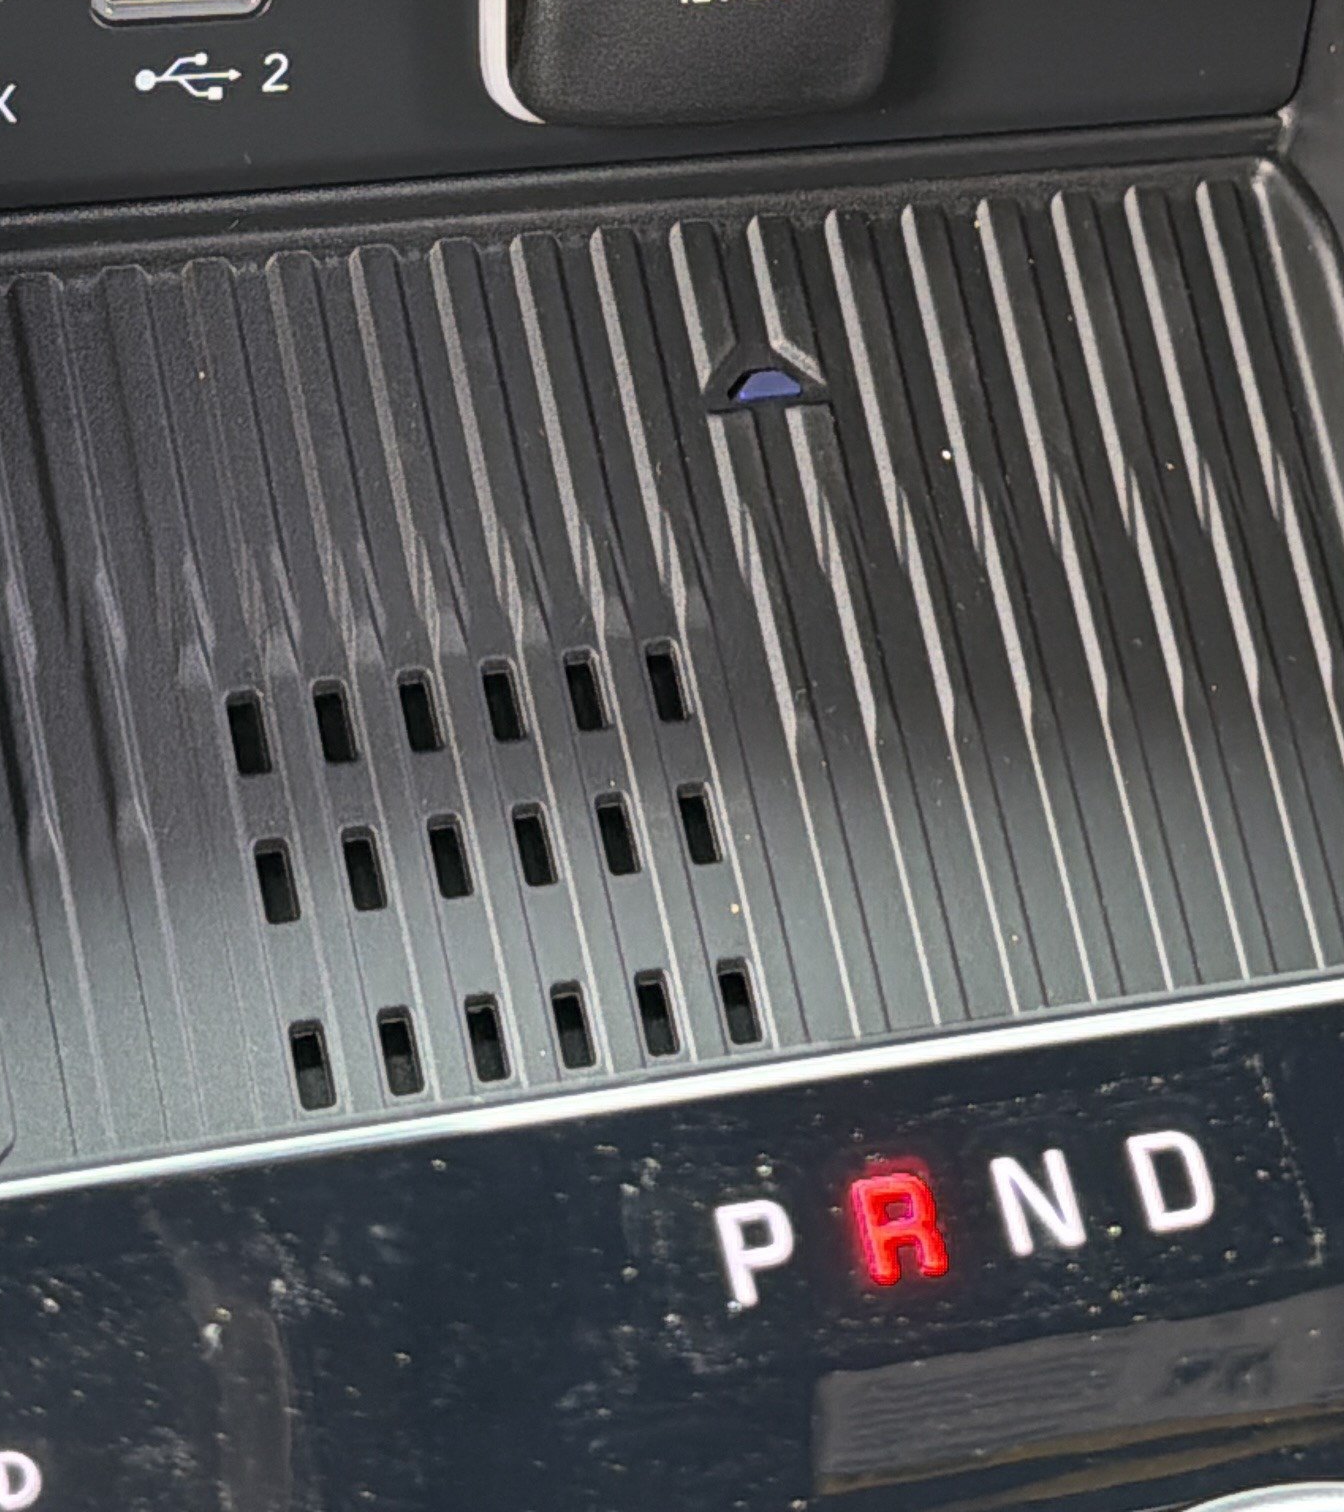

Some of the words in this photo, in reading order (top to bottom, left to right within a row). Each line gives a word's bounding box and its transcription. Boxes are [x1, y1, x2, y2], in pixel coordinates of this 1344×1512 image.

[261, 52, 289, 93] 2
[714, 1199, 794, 1308] P
[851, 1172, 949, 1286] R
[989, 1148, 1087, 1256] N
[1125, 1129, 1215, 1233] D
